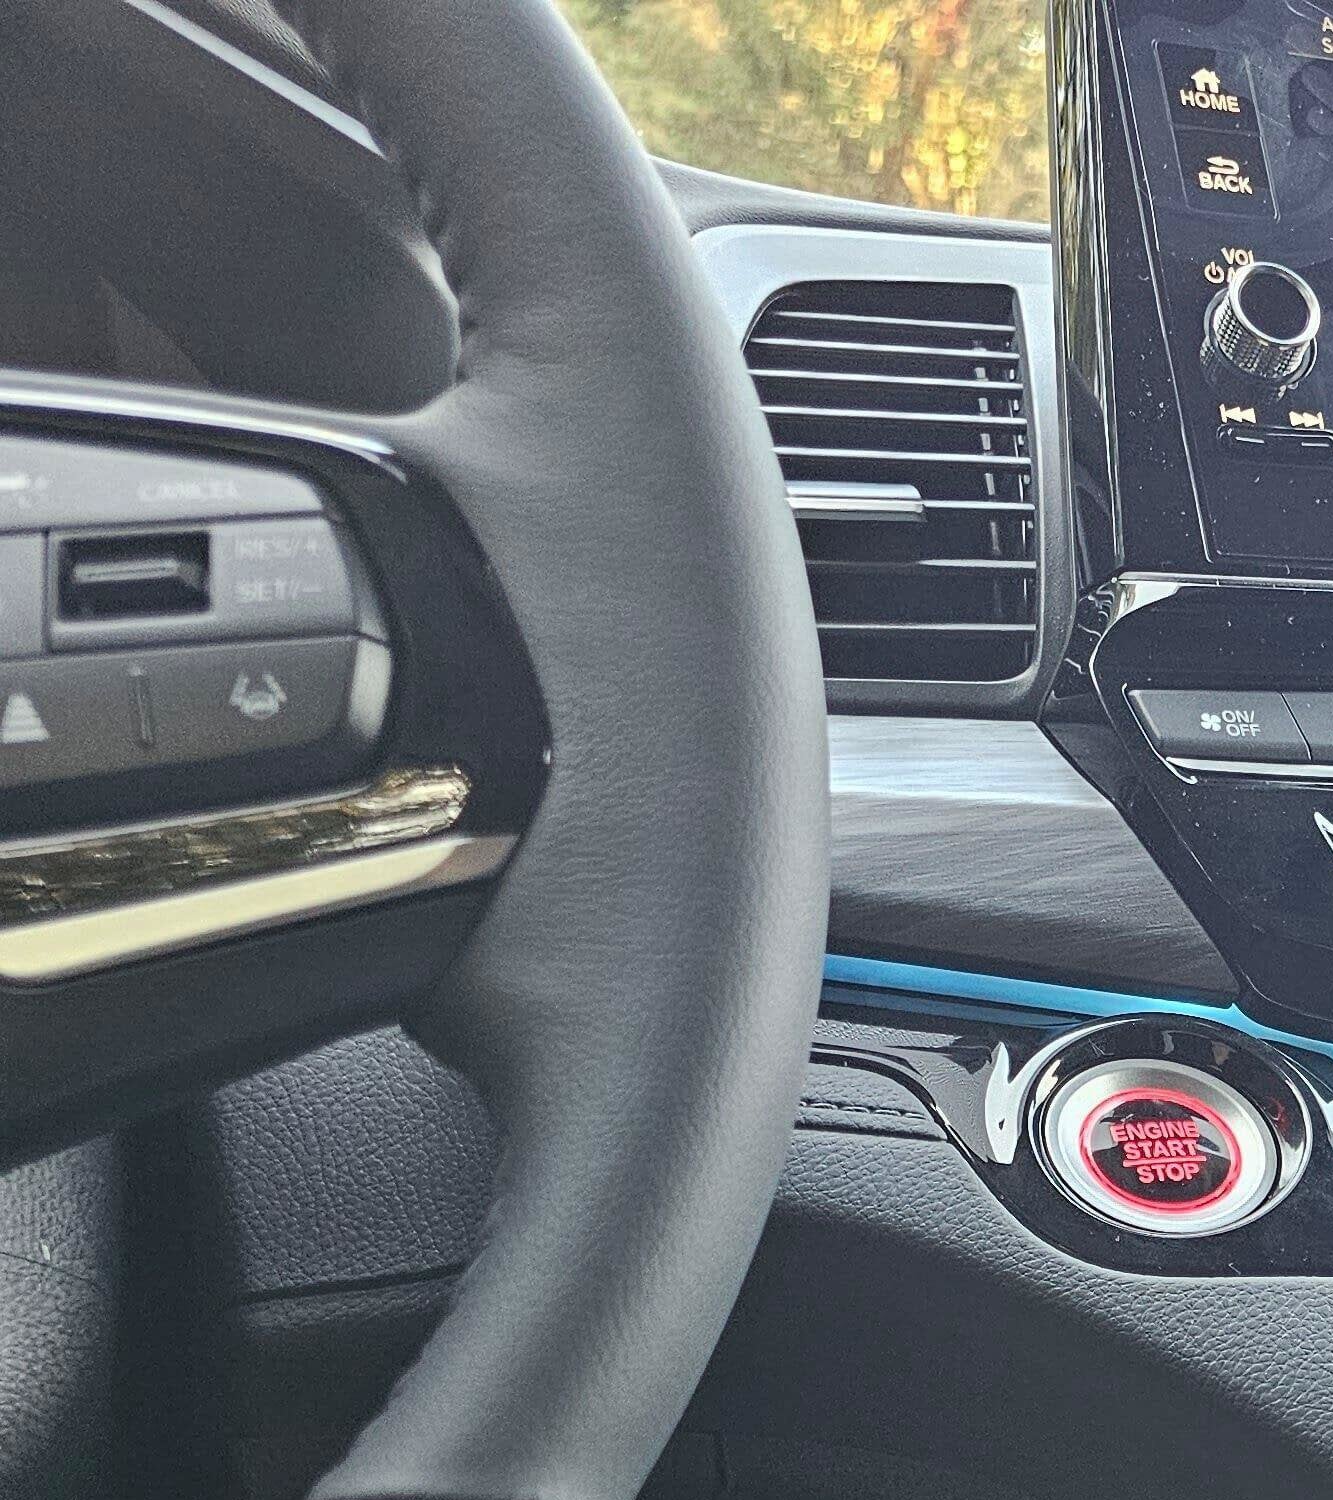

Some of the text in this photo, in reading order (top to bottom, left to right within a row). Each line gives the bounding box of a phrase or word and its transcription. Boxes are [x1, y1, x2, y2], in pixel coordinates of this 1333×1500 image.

[1180, 89, 1240, 113] HOME
[1198, 171, 1253, 195] BACK
[1221, 710, 1256, 723] ON/
[1226, 722, 1262, 738] OFF
[1109, 1120, 1200, 1143] ENGINE
[1122, 1139, 1198, 1159] START
[1136, 1163, 1200, 1184] STOP
